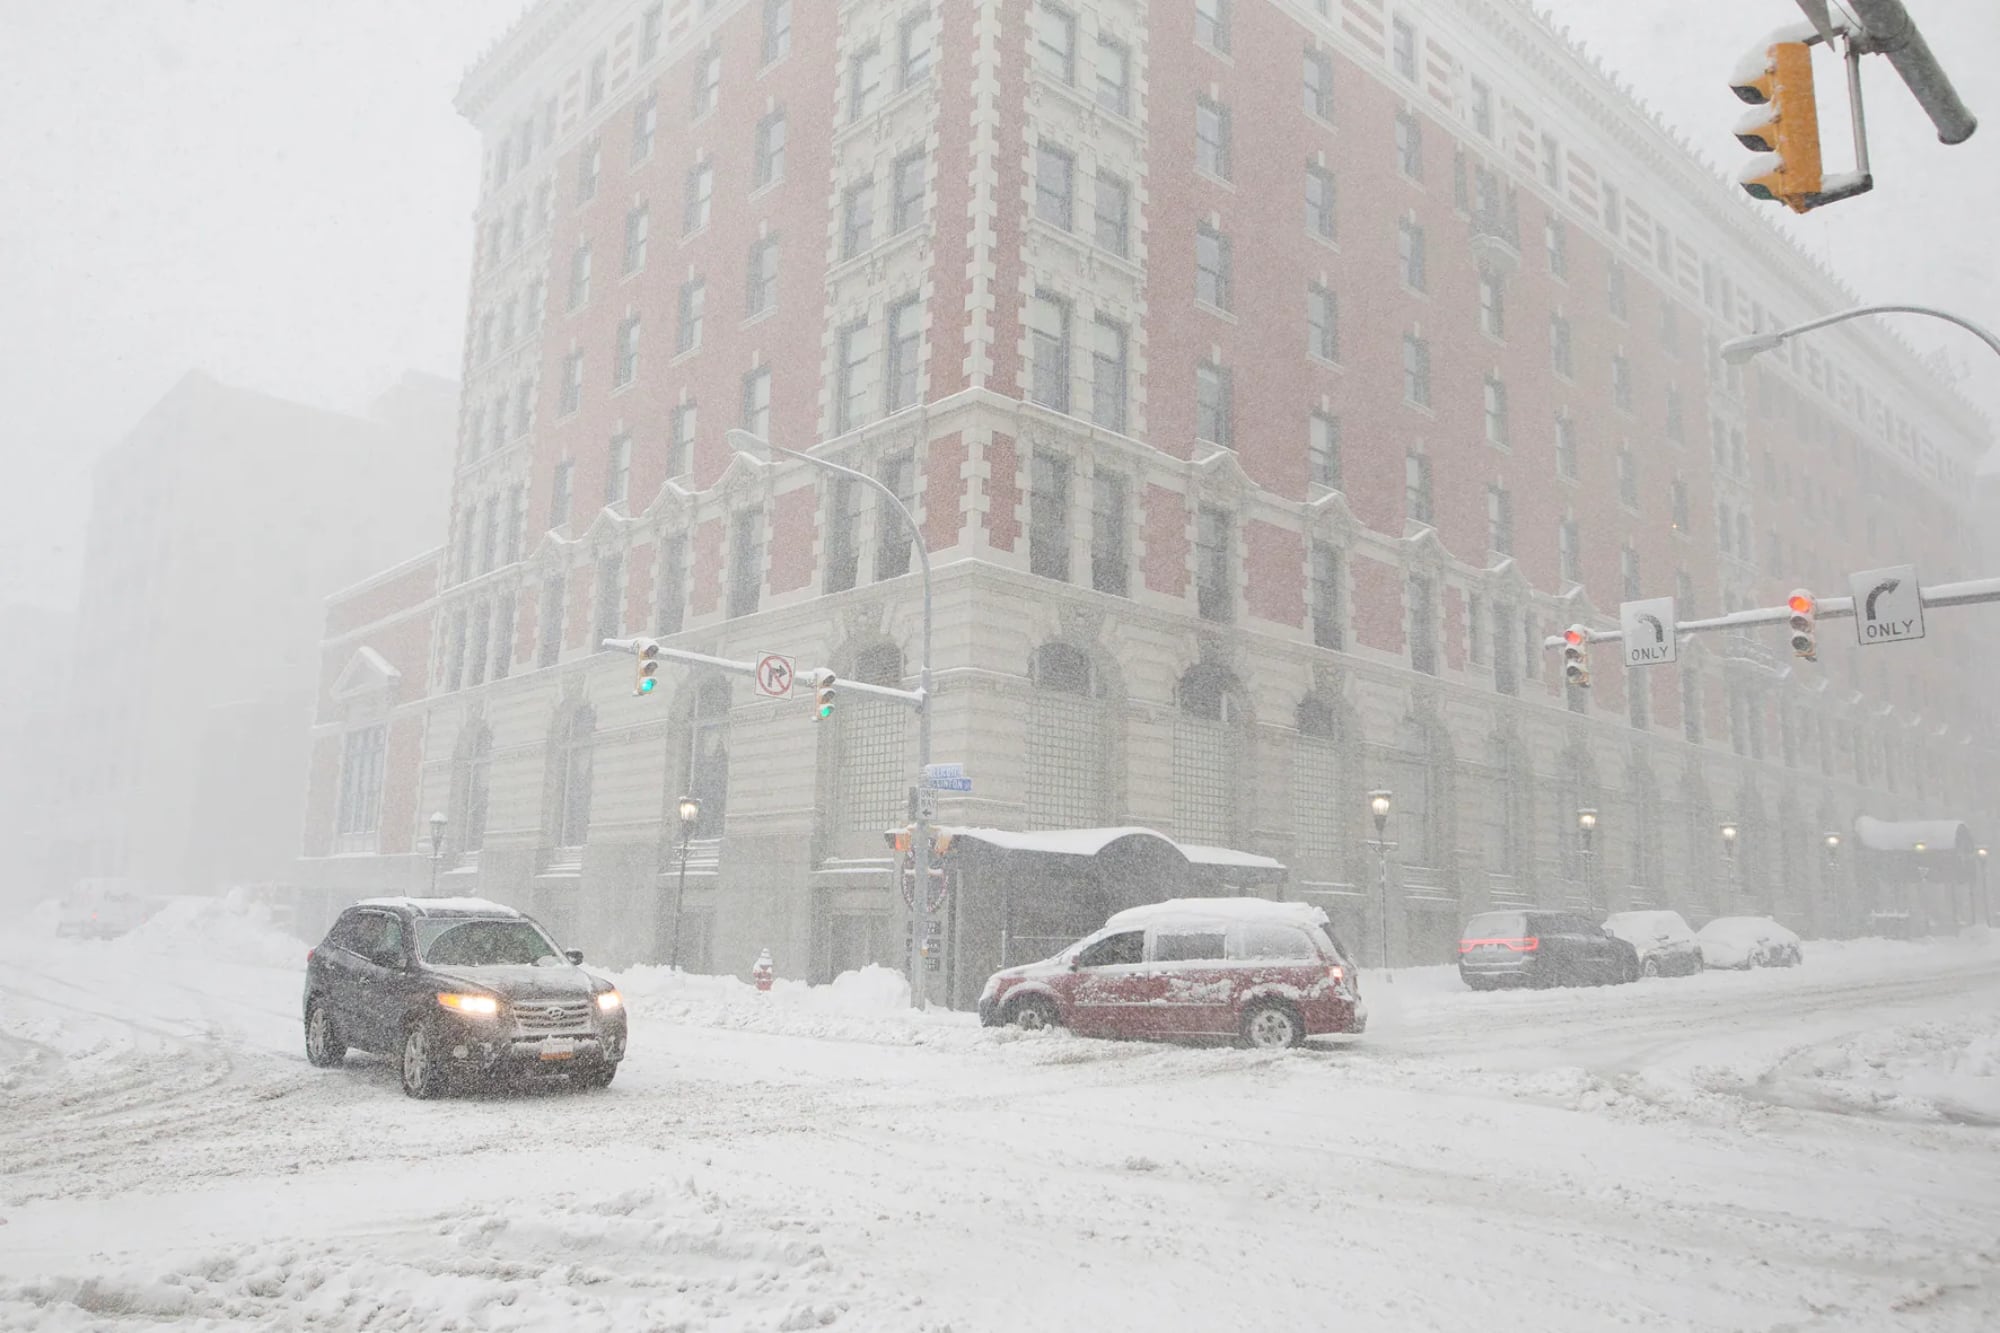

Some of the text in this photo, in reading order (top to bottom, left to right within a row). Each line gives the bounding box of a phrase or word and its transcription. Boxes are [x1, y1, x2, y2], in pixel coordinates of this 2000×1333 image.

[1866, 619, 1914, 638] ONLY
[1632, 646, 1668, 661] ONLY
[932, 779, 963, 790] CLINTON
[920, 791, 935, 799] ONE
[920, 799, 936, 809] WAY
